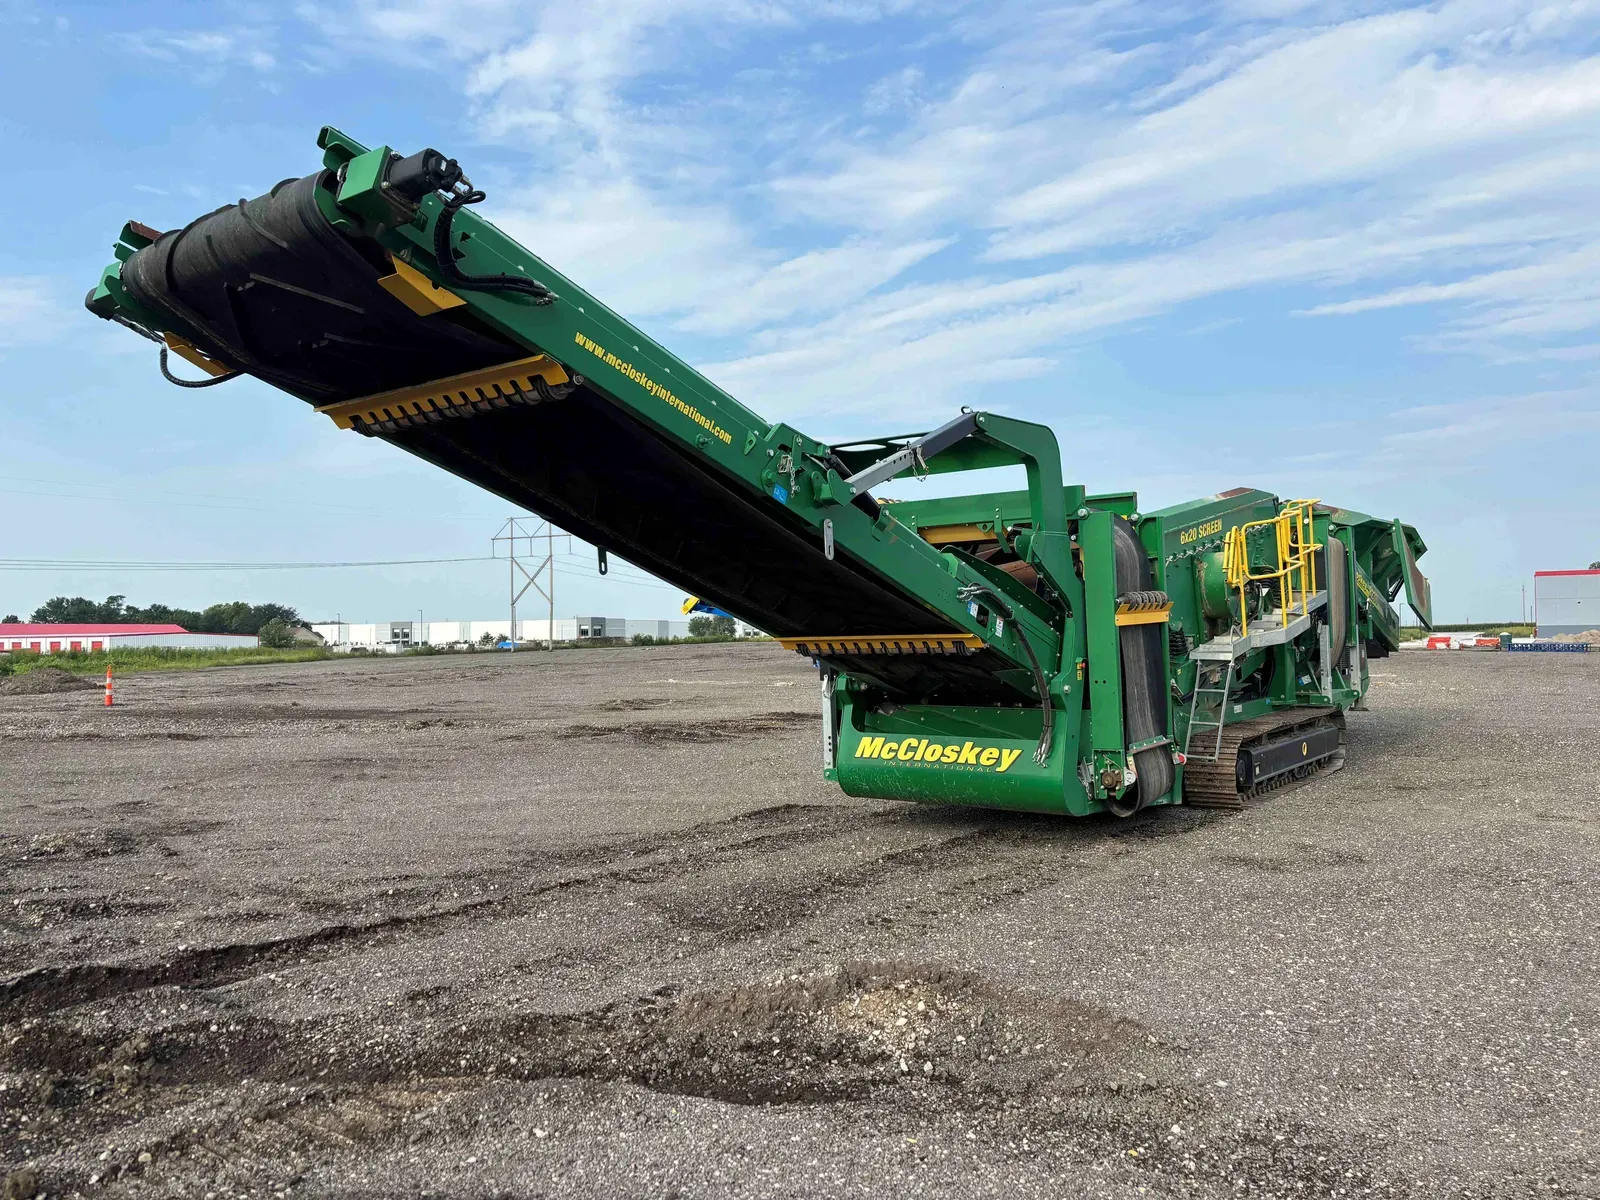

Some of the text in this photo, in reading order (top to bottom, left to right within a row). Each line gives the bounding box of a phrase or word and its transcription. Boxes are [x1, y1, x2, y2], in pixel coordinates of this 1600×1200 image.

[574, 331, 733, 445] www.mccloskeyinternational.com
[1180, 518, 1223, 545] 6x20 SCREEN
[854, 736, 1024, 773] McCloskey
[883, 760, 993, 773] INTERNATIONAL
